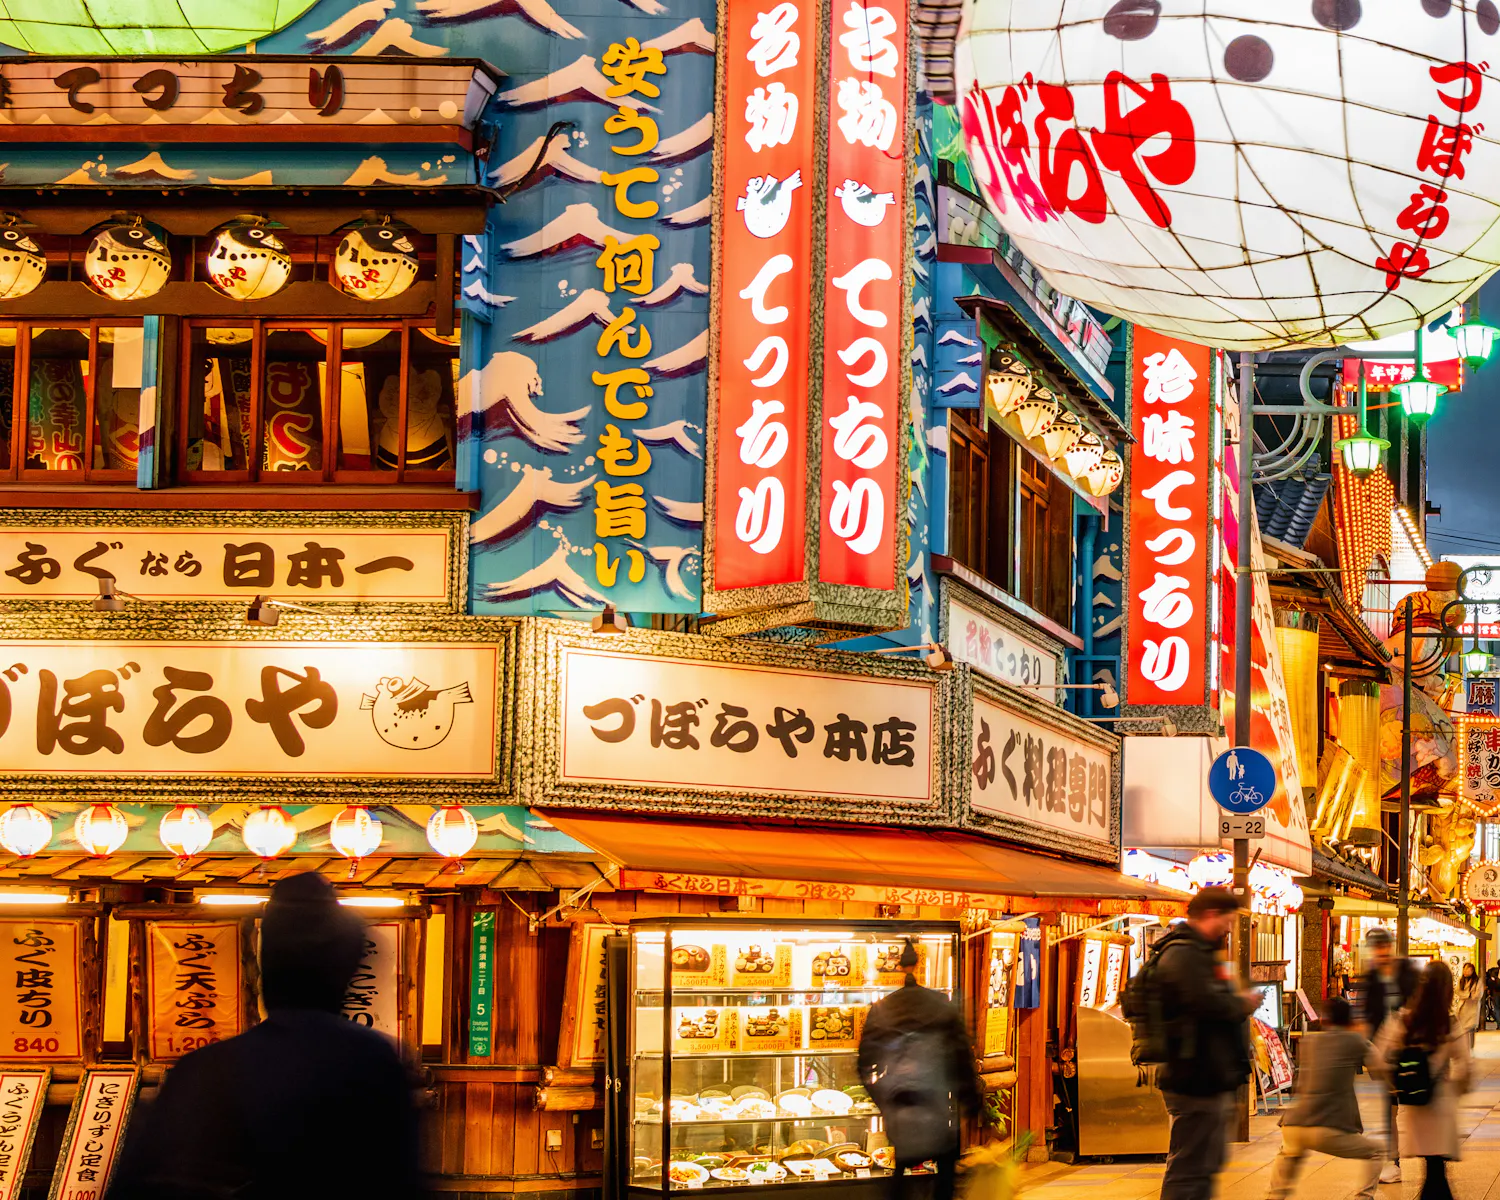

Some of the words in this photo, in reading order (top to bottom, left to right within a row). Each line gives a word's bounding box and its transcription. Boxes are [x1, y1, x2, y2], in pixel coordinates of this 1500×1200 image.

[1375, 60, 1490, 291] づぼらや
[592, 37, 667, 588] 安うて何んでも旨い
[582, 693, 918, 768] づぼらや本店
[971, 716, 1107, 829] ふぐ料理専門
[1466, 727, 1483, 789] お好み焼き
[13, 928, 57, 1028] ふぐ皮ちり
[174, 933, 218, 1029] ふぐ天ぷら
[476, 1003, 485, 1016] 5
[13, 1037, 60, 1053] 840
[76, 1082, 121, 1183] にぎりずし定食
